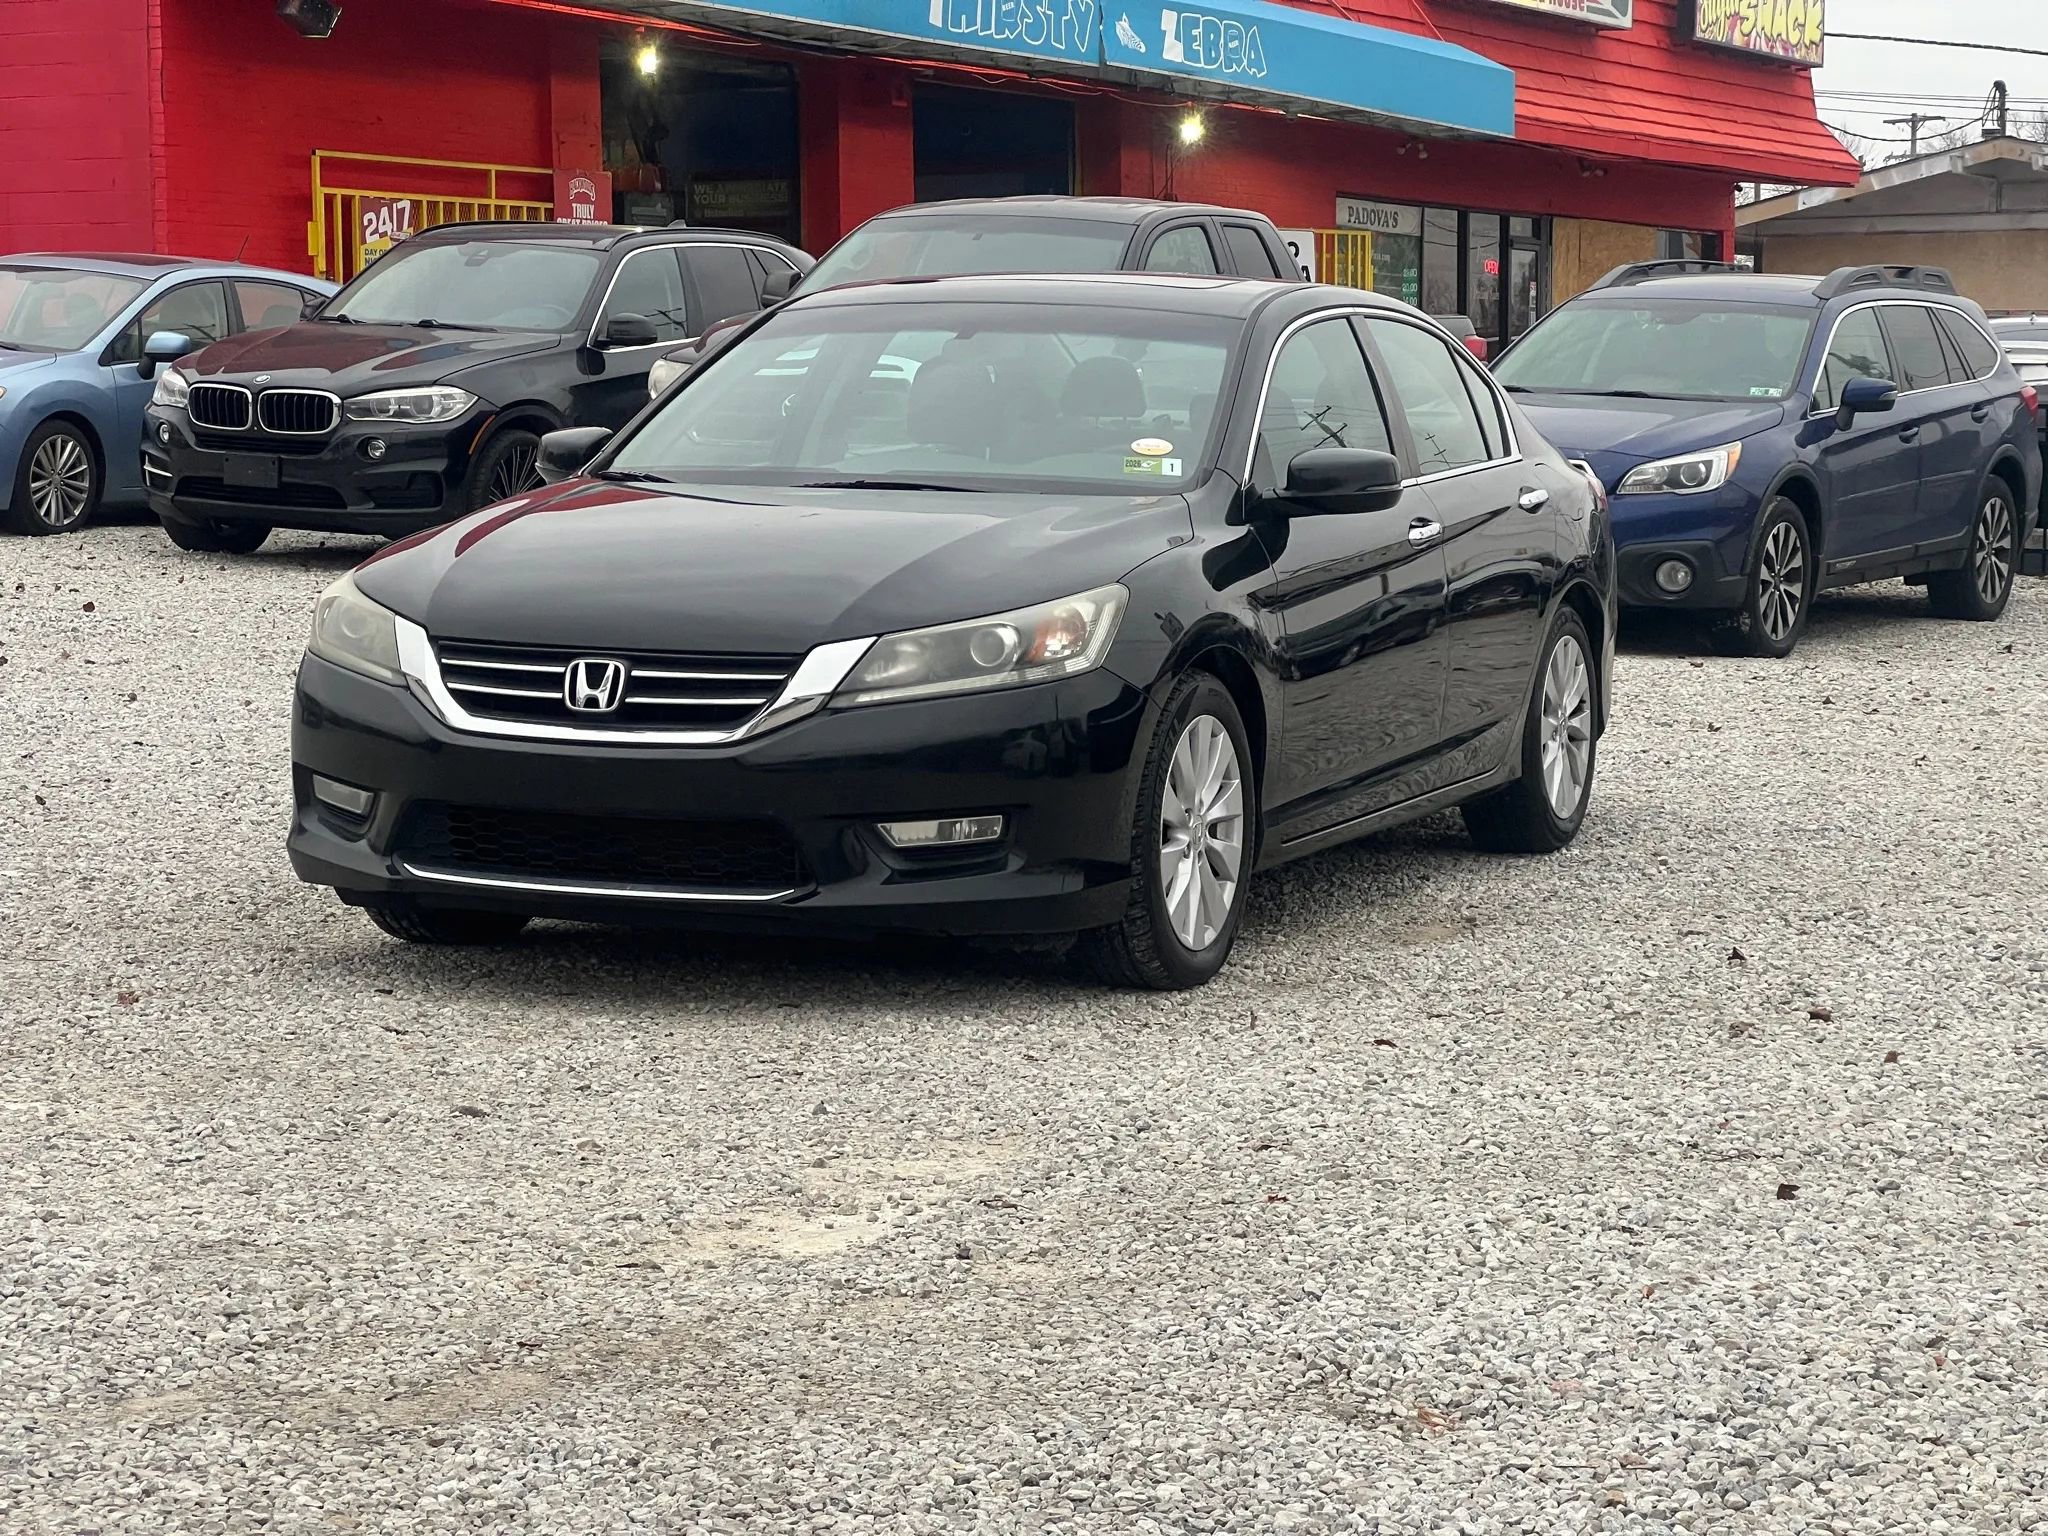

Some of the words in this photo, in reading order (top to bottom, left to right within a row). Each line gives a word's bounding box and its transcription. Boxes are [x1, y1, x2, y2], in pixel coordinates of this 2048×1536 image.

[1739, 0, 1822, 49] SHACK
[1161, 8, 1268, 78] ZEBRA
[693, 194, 726, 205] YOUR
[571, 203, 594, 219] TRULY
[1347, 206, 1399, 228] PADOVA'S
[364, 248, 378, 256] DAY
